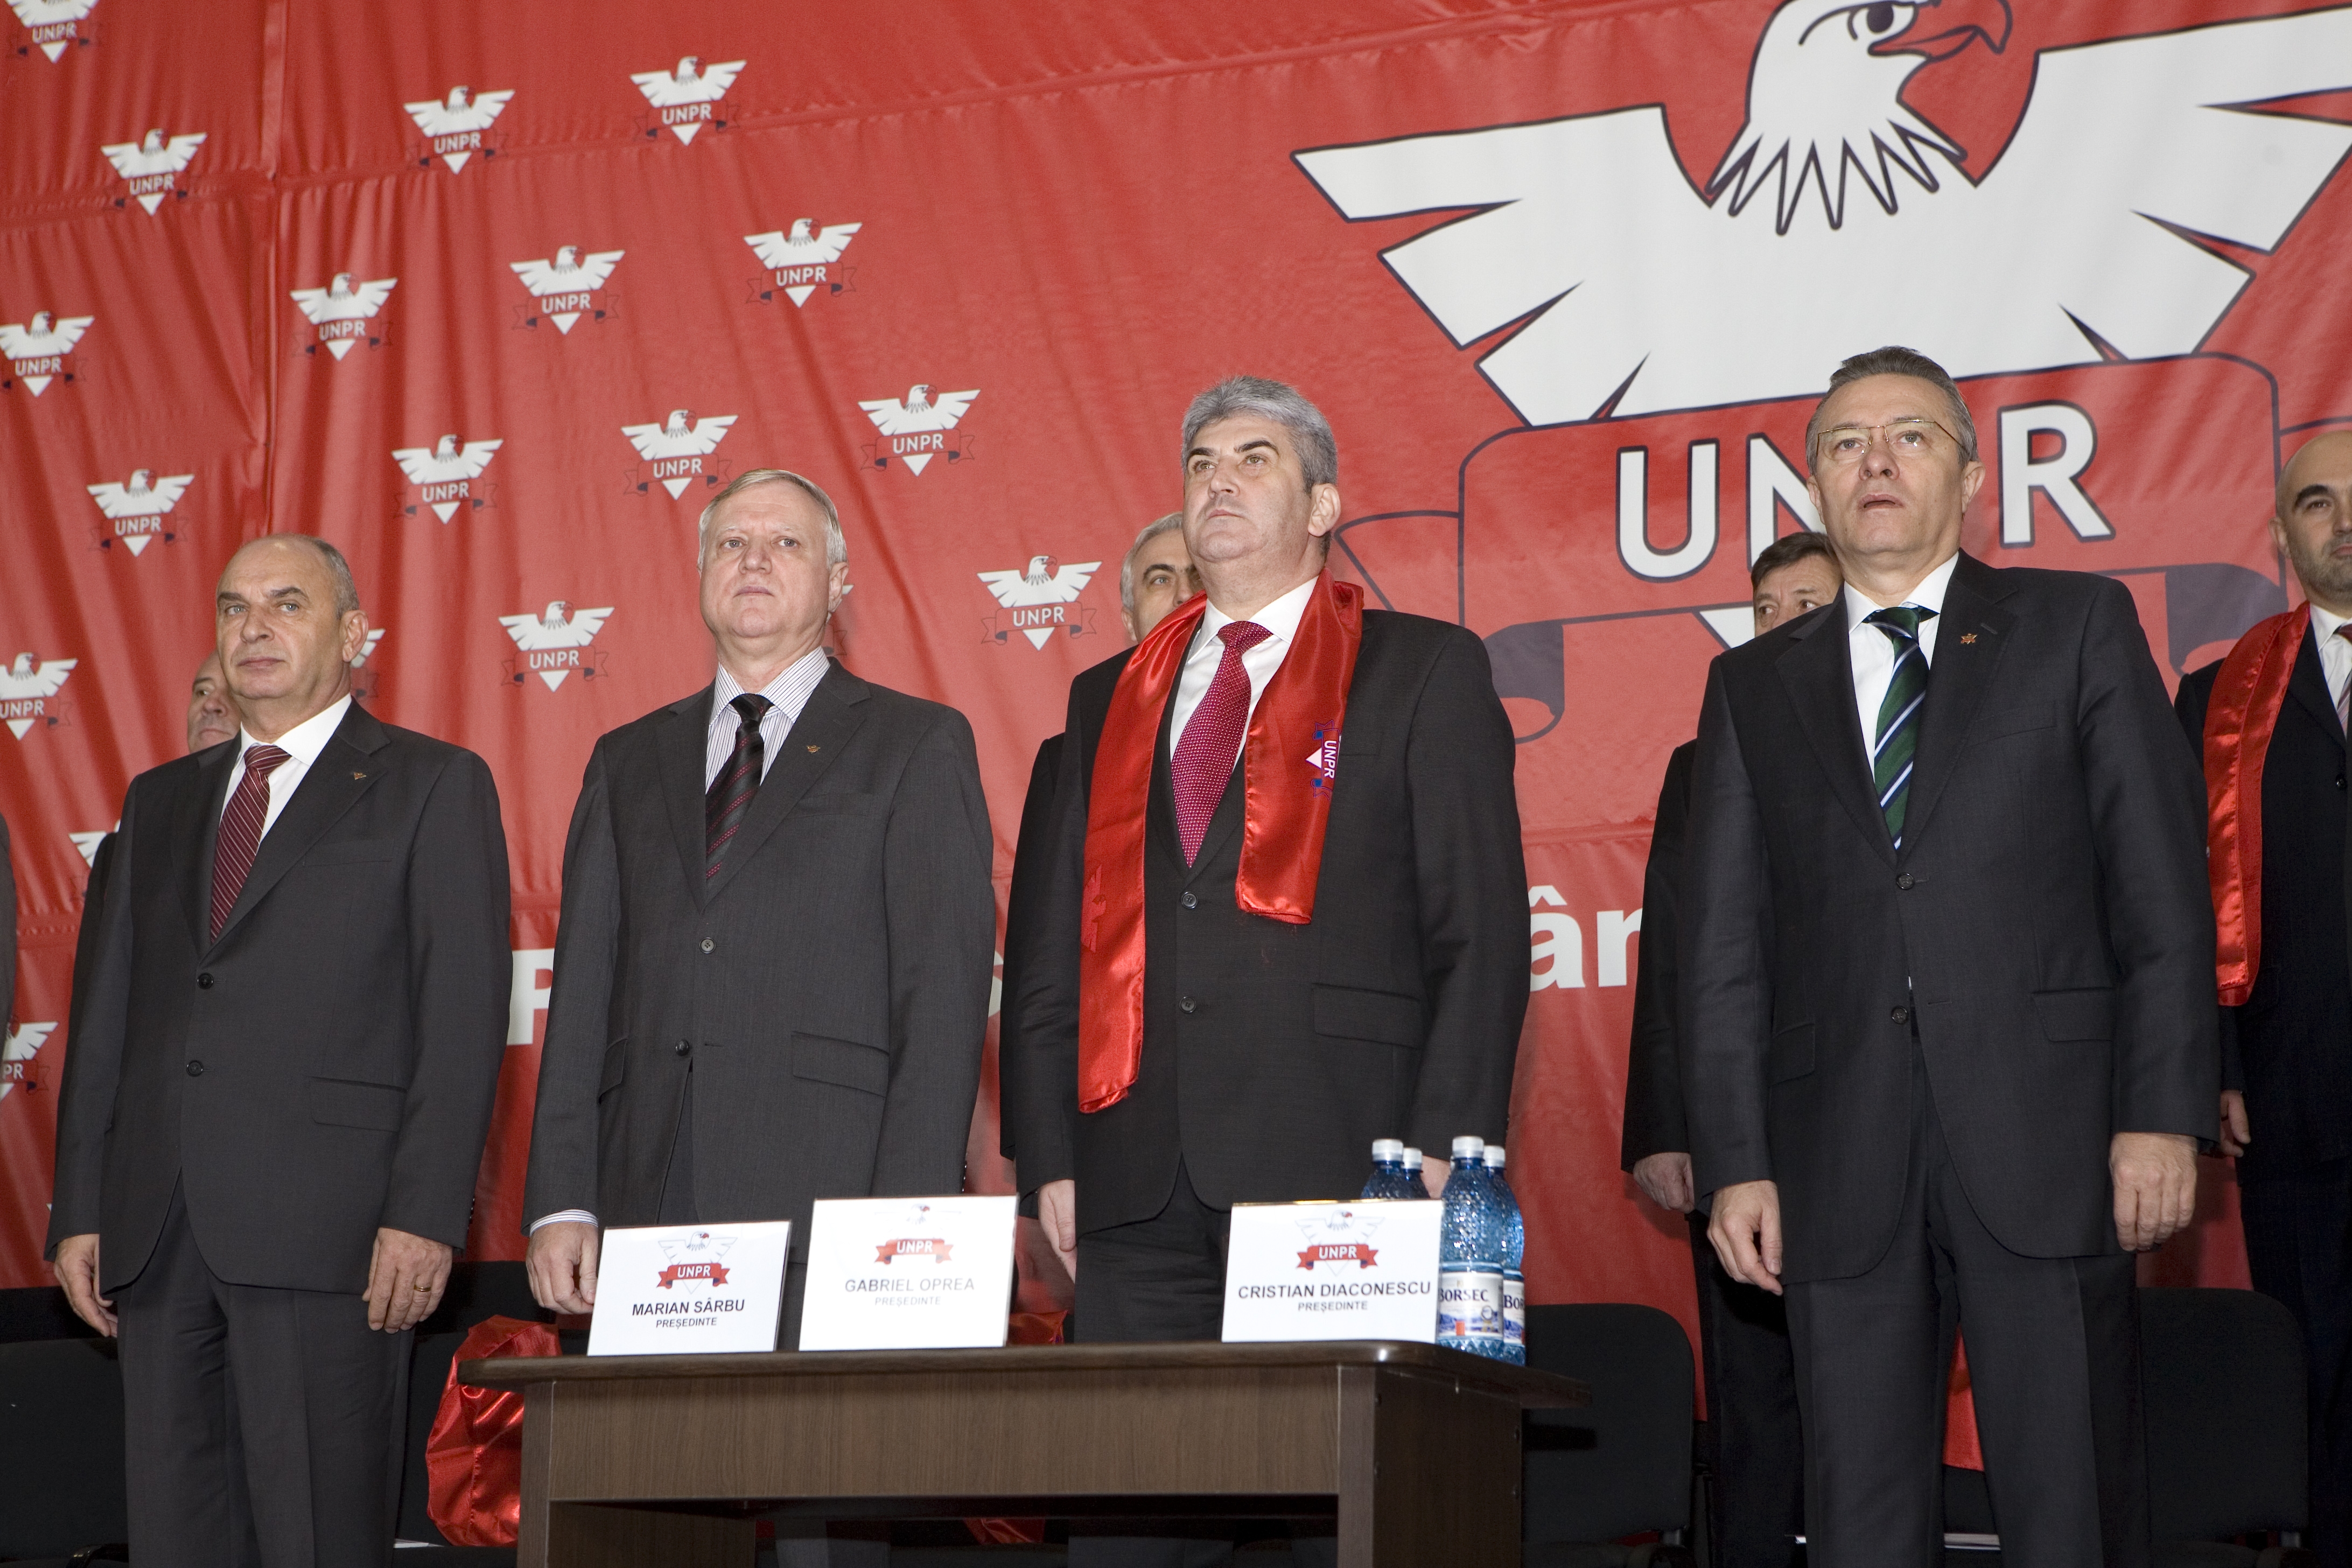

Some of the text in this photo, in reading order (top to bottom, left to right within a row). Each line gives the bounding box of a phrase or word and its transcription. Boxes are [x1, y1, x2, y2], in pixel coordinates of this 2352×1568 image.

[32, 22, 76, 43] UNPR
[662, 103, 711, 124] UNPR
[434, 131, 481, 153] UNPR
[129, 174, 174, 195] UNPR
[776, 265, 827, 286] UNPR
[542, 292, 591, 313] UNPR
[320, 320, 366, 340] UNPR
[15, 357, 62, 376] UNPR
[893, 433, 943, 454] UNPR
[653, 458, 702, 478] UNPR
[421, 482, 468, 503] UNPR
[1615, 400, 2114, 582] UNR
[115, 515, 161, 535] UNPR
[1013, 606, 1065, 627] UNPR
[529, 650, 579, 669] UNPR
[1324, 740, 1337, 779] UNPR
[897, 1240, 933, 1254] UNPR
[1319, 1245, 1357, 1260] UNPR
[677, 1265, 711, 1278] UNPR
[845, 1278, 975, 1292] GABRIEL OPREA
[1238, 1281, 1431, 1299] CRISTIAN DIACONESCU
[632, 1297, 745, 1315] MARIAN SÂRBU
